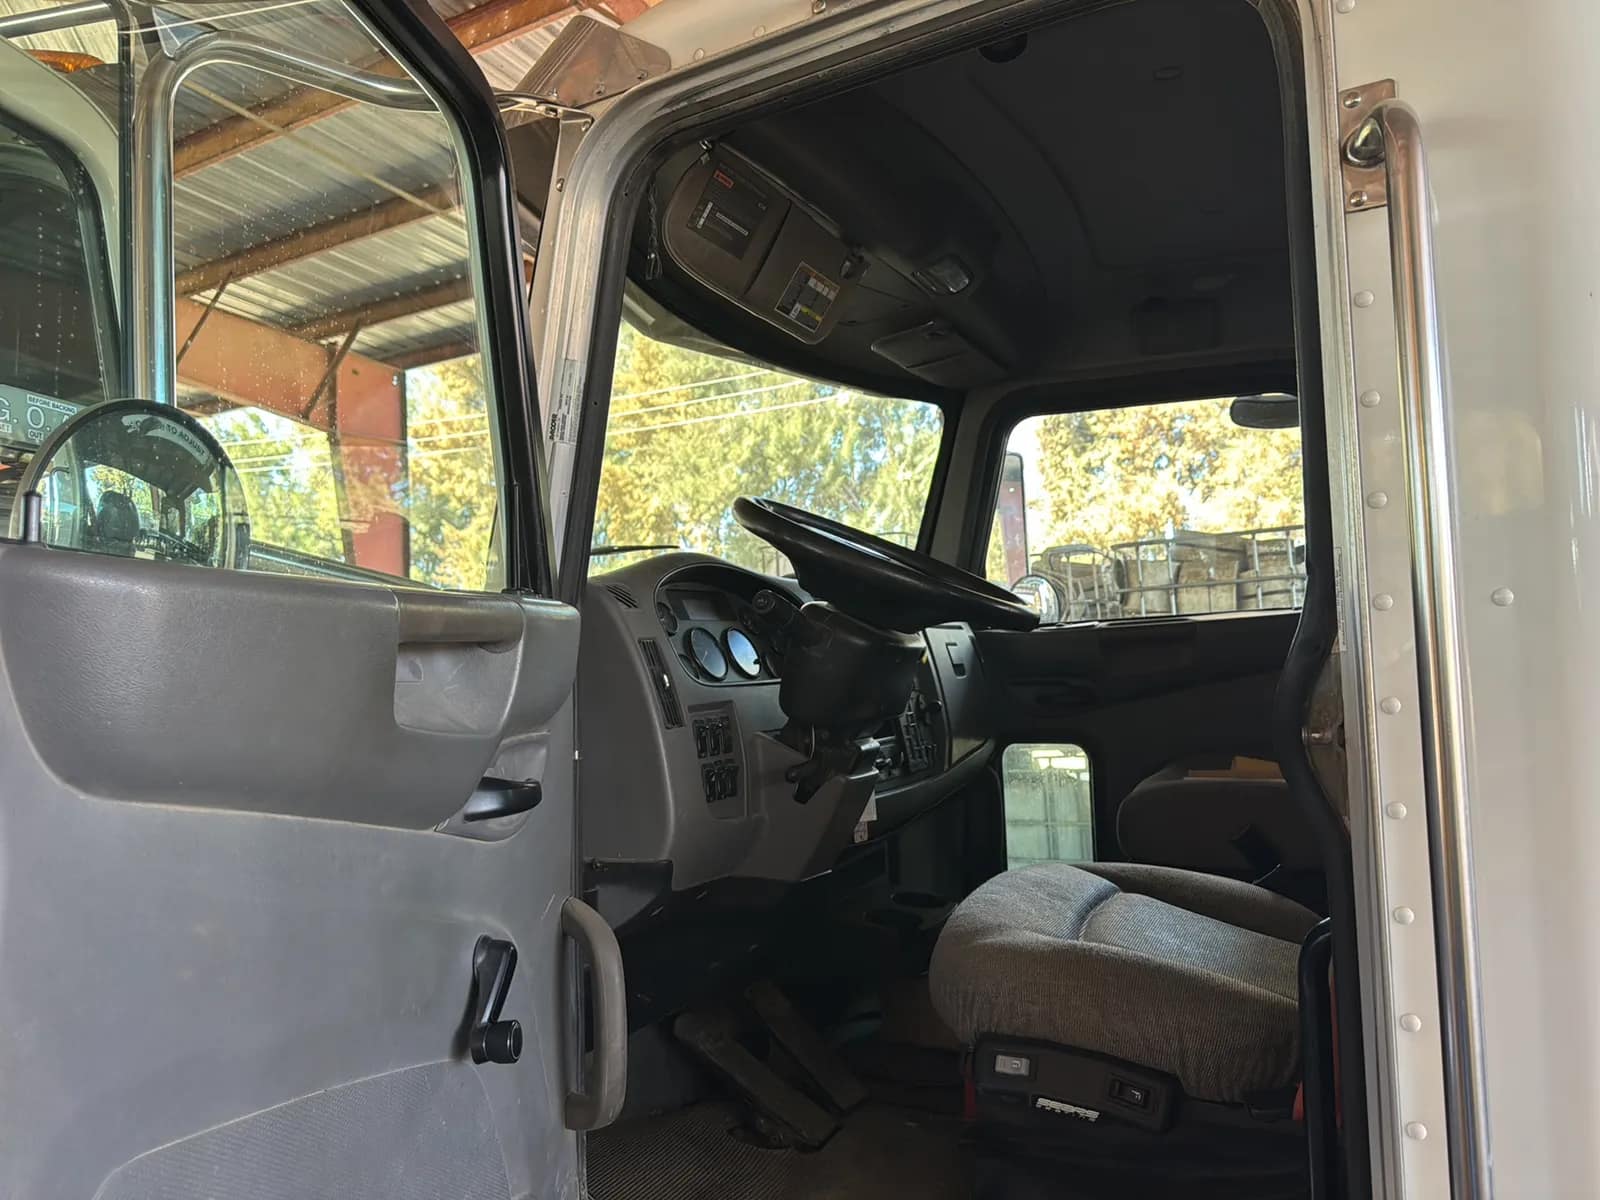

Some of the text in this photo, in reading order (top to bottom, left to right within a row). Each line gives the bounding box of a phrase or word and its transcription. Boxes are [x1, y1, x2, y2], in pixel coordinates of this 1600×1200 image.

[28, 395, 76, 414] BEFORE BACKING
[29, 430, 43, 440] OUT
[165, 423, 177, 434] TO
[177, 431, 206, 456] ADJUST
